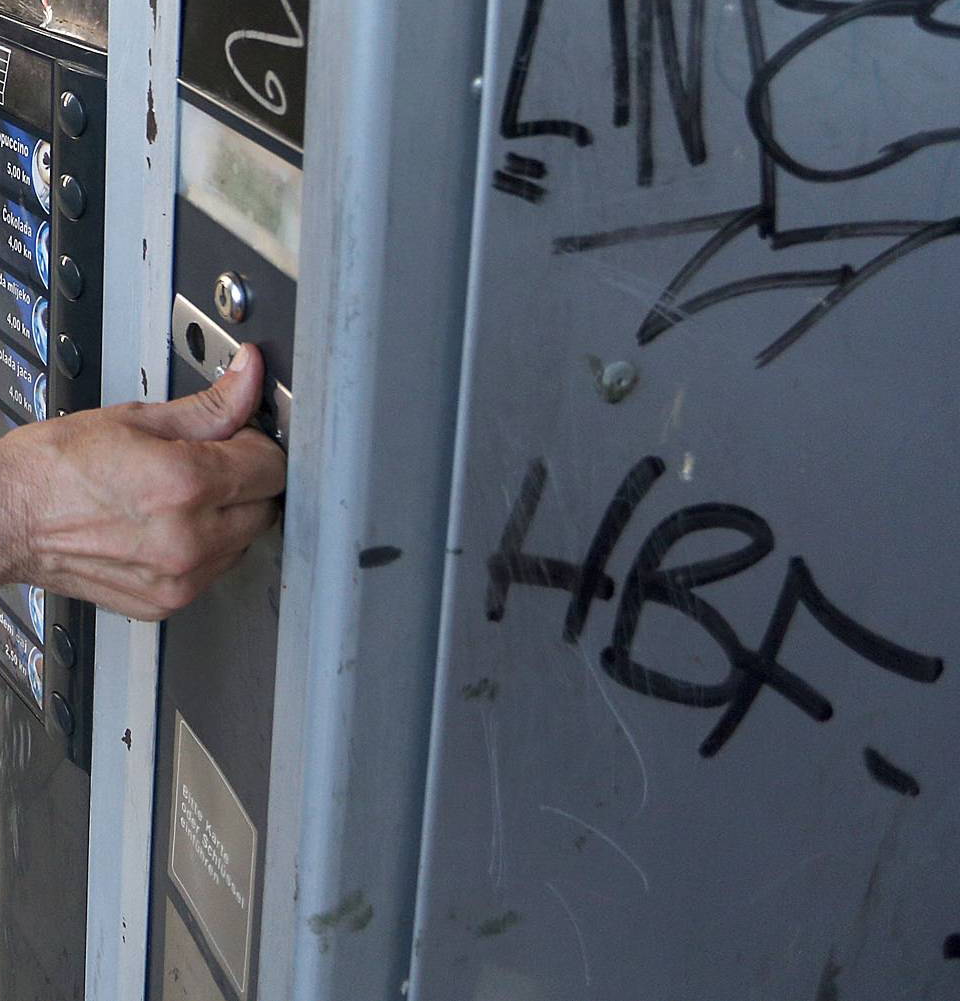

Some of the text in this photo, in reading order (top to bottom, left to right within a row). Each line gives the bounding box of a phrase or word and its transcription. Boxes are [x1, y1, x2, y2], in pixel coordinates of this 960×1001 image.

[7, 161, 31, 186] 5,00 kn
[2, 204, 32, 237] Čokolada
[7, 235, 32, 260] 4,00 kn
[7, 281, 31, 305] mlijeko
[6, 312, 31, 339] 4,00 kn
[8, 386, 32, 413] 4,00 kn
[5, 643, 18, 666] 2,50
[181, 802, 244, 909] oder Schlüssel
[205, 820, 229, 865] Karte
